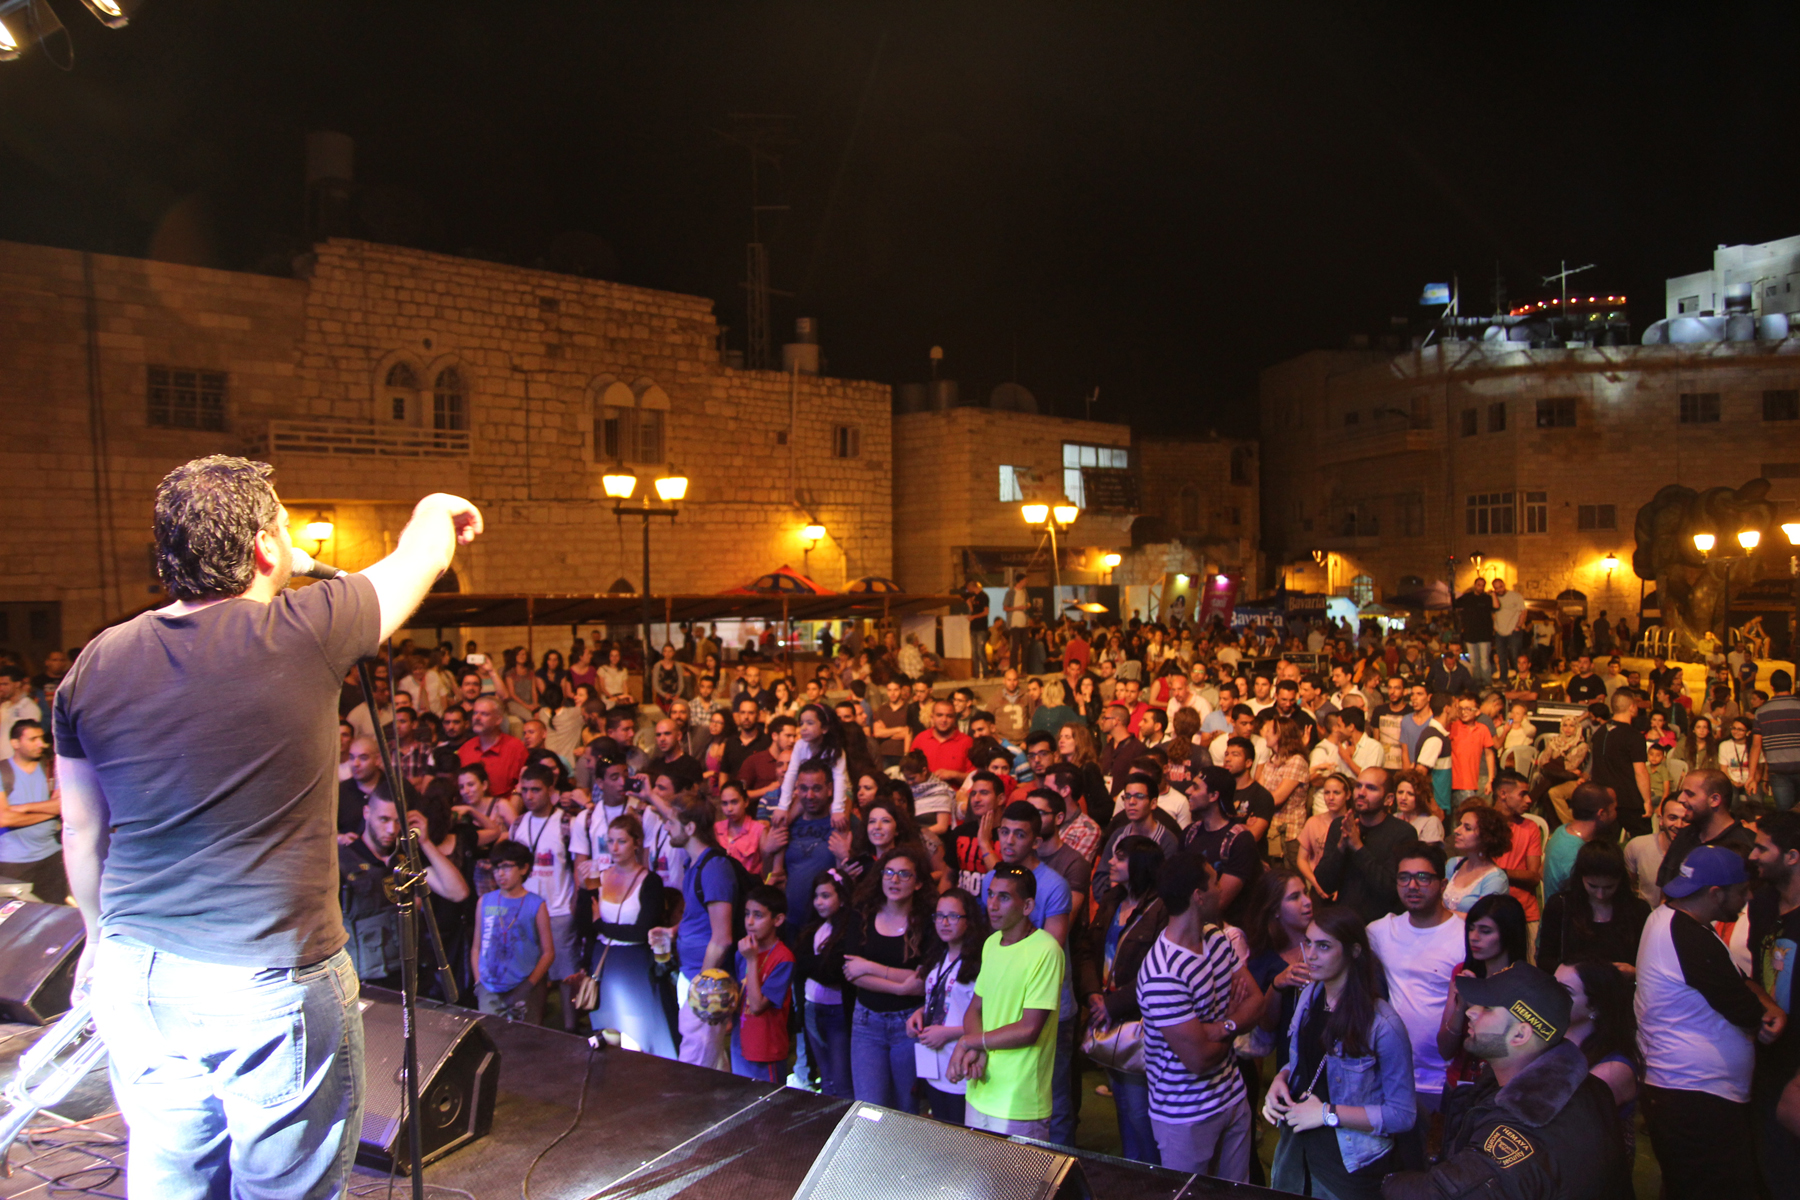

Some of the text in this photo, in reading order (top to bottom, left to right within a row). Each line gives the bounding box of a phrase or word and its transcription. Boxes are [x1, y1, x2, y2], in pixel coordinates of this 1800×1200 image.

[1289, 595, 1325, 611] Bavaria
[1230, 611, 1283, 627] Bavaria
[1514, 1004, 1543, 1030] HEMAYA
[1502, 1128, 1529, 1151] HEMAYA
